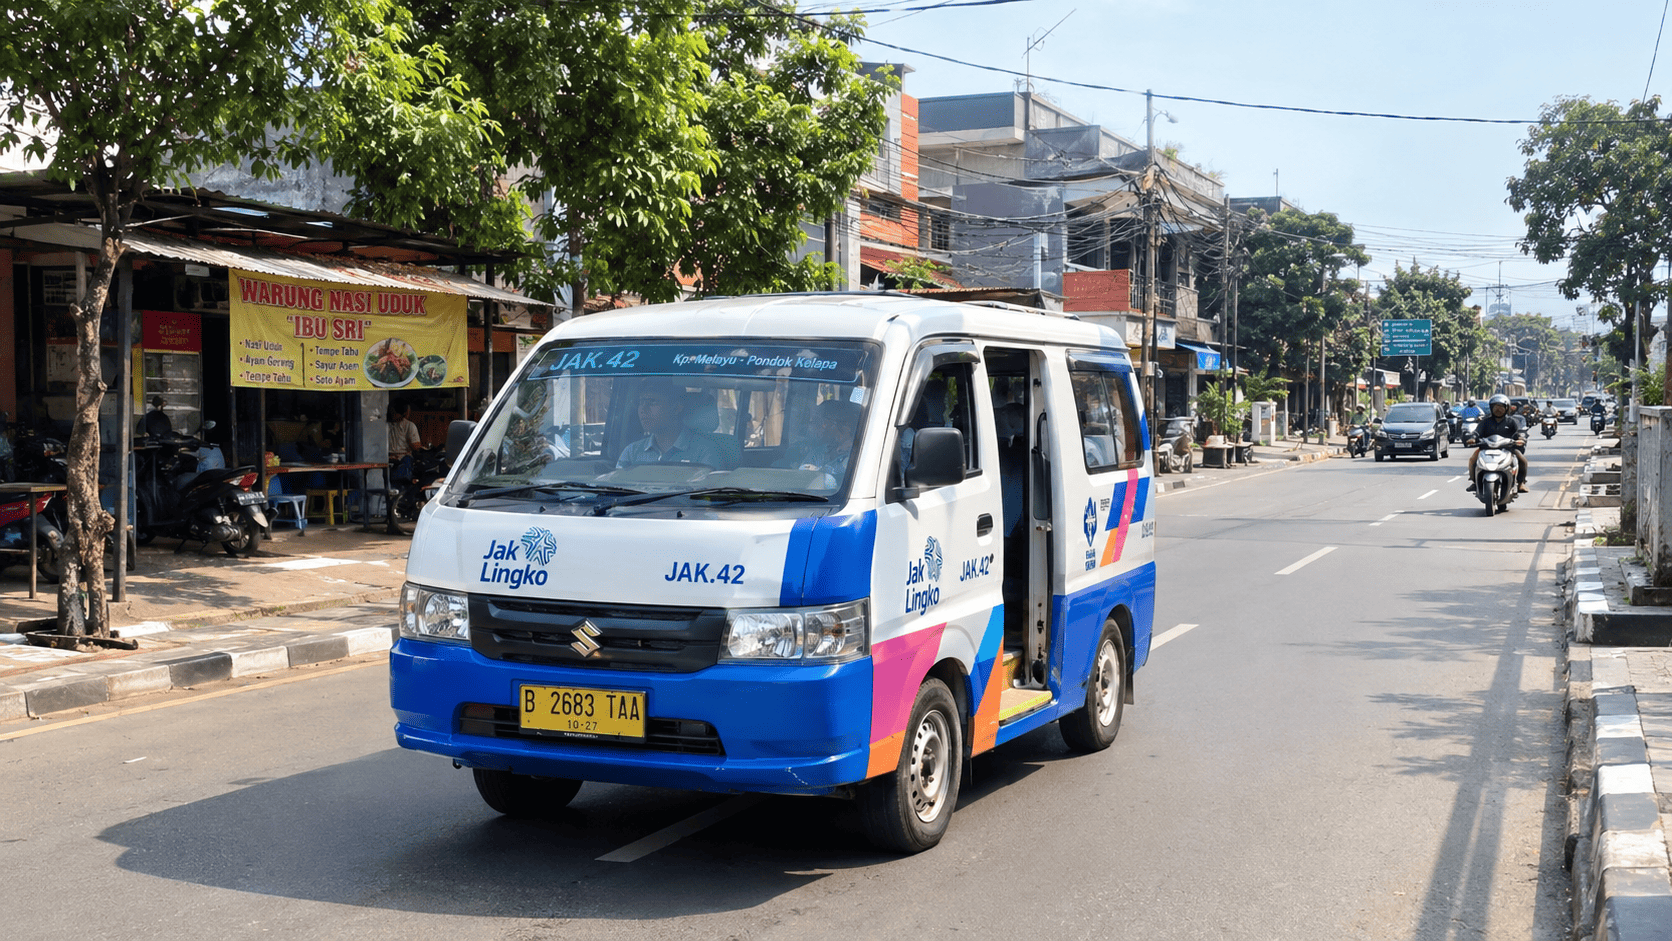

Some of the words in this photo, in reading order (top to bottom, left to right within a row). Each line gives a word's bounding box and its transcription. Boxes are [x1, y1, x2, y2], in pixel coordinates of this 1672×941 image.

[239, 277, 323, 311] WARUNG
[329, 290, 371, 314] NASI
[378, 293, 426, 315] UDUK
[315, 360, 336, 372] Sayur
[549, 350, 640, 371] JAK.42
[694, 354, 737, 367] Melayu
[747, 355, 792, 368] Pondok
[483, 539, 520, 561] Jak
[480, 562, 549, 590] Lingko
[664, 561, 746, 585] JAK.42
[906, 558, 925, 586] Jak
[960, 555, 990, 582] JAK.42
[905, 583, 940, 616] Lingko
[524, 689, 536, 714] B
[550, 691, 595, 717] 2683
[606, 694, 640, 721] TAA
[567, 719, 598, 731] 10-27
